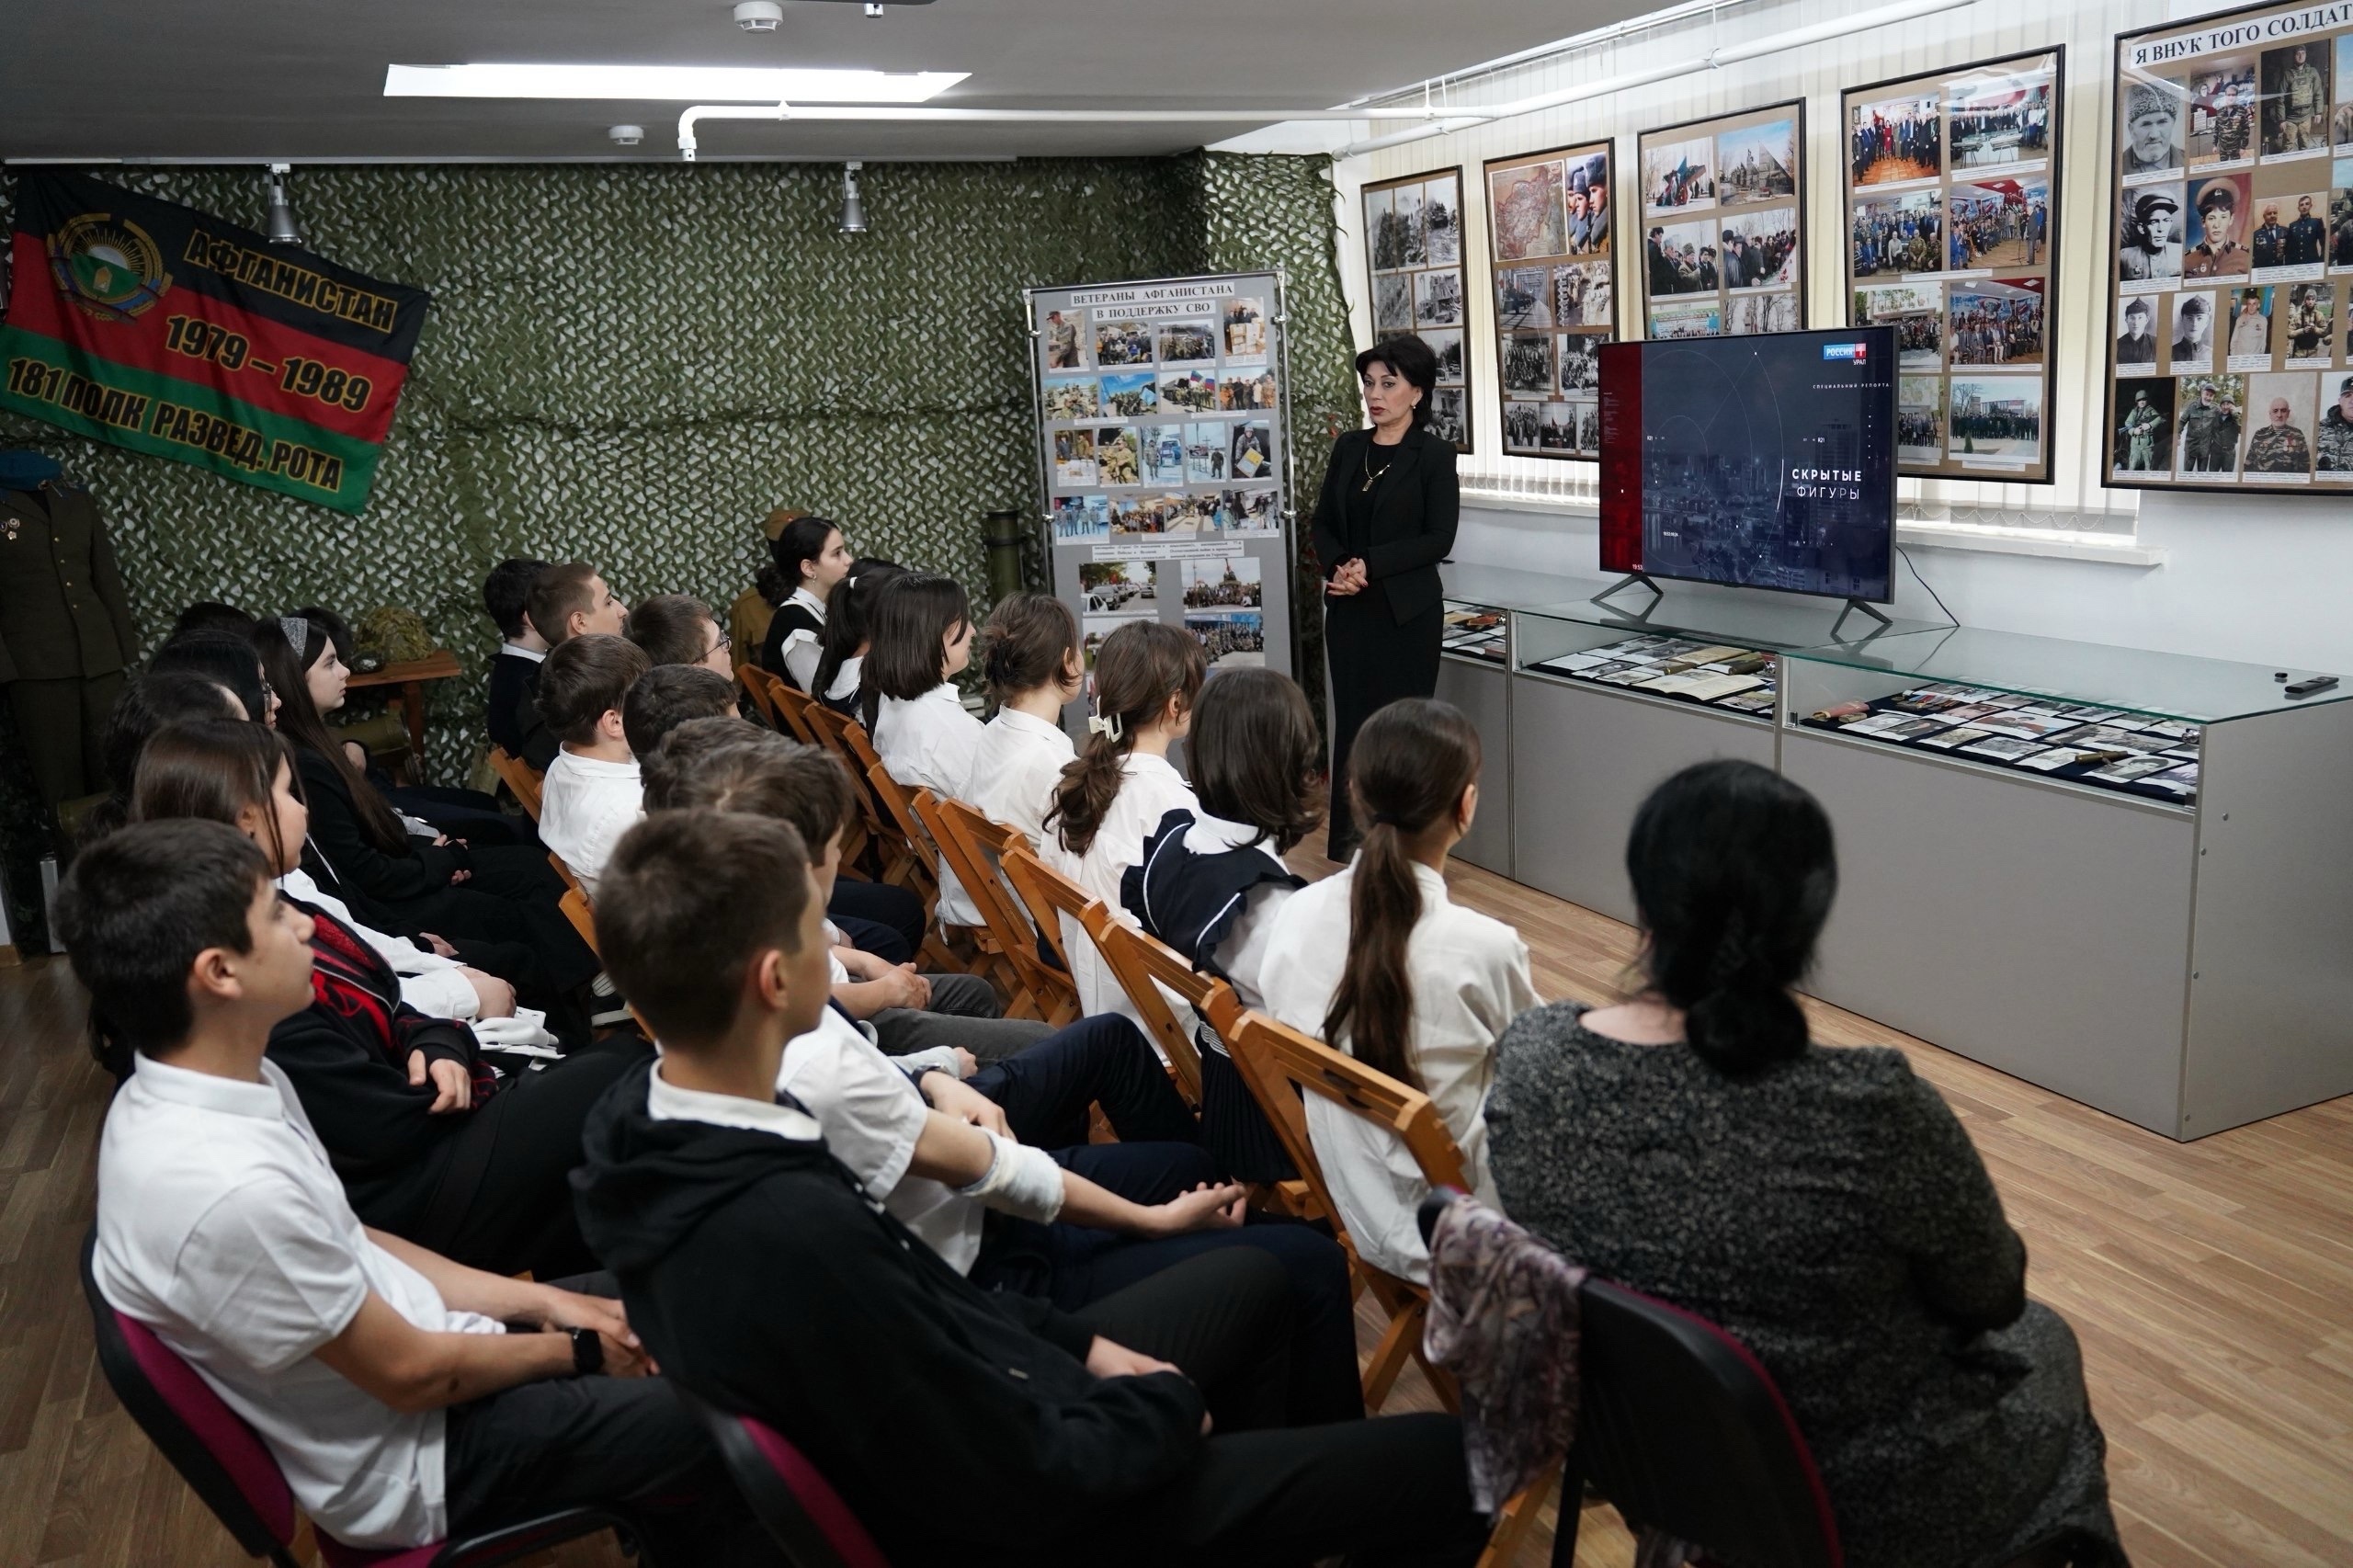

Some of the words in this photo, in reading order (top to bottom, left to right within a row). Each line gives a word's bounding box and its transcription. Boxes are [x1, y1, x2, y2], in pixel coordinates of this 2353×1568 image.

[2135, 49, 2147, 64] Я
[2153, 37, 2202, 61] ВНУК
[2210, 24, 2260, 49] ТОГО
[2268, 4, 2353, 36] СОЛДАТ
[183, 230, 398, 333] АФГАНИСТАН
[1074, 291, 1135, 304] ВЕТЕРАНЫ
[1142, 285, 1233, 300] АФГАНИСТАНА
[1108, 305, 1181, 318] ПОДДЕРЖКУ
[1186, 302, 1211, 313] СВО
[1826, 347, 1853, 357] РОССИЯ
[166, 314, 249, 371] 1979
[279, 354, 372, 414] 1989
[7, 358, 60, 403] 181
[60, 373, 151, 432] ПОЛК
[150, 402, 265, 472] РАЗВЕД.
[270, 441, 343, 494] РОТА
[1791, 469, 1861, 481] СКРЫТЫЕ
[1797, 485, 1859, 500] ФИГУРЫ
